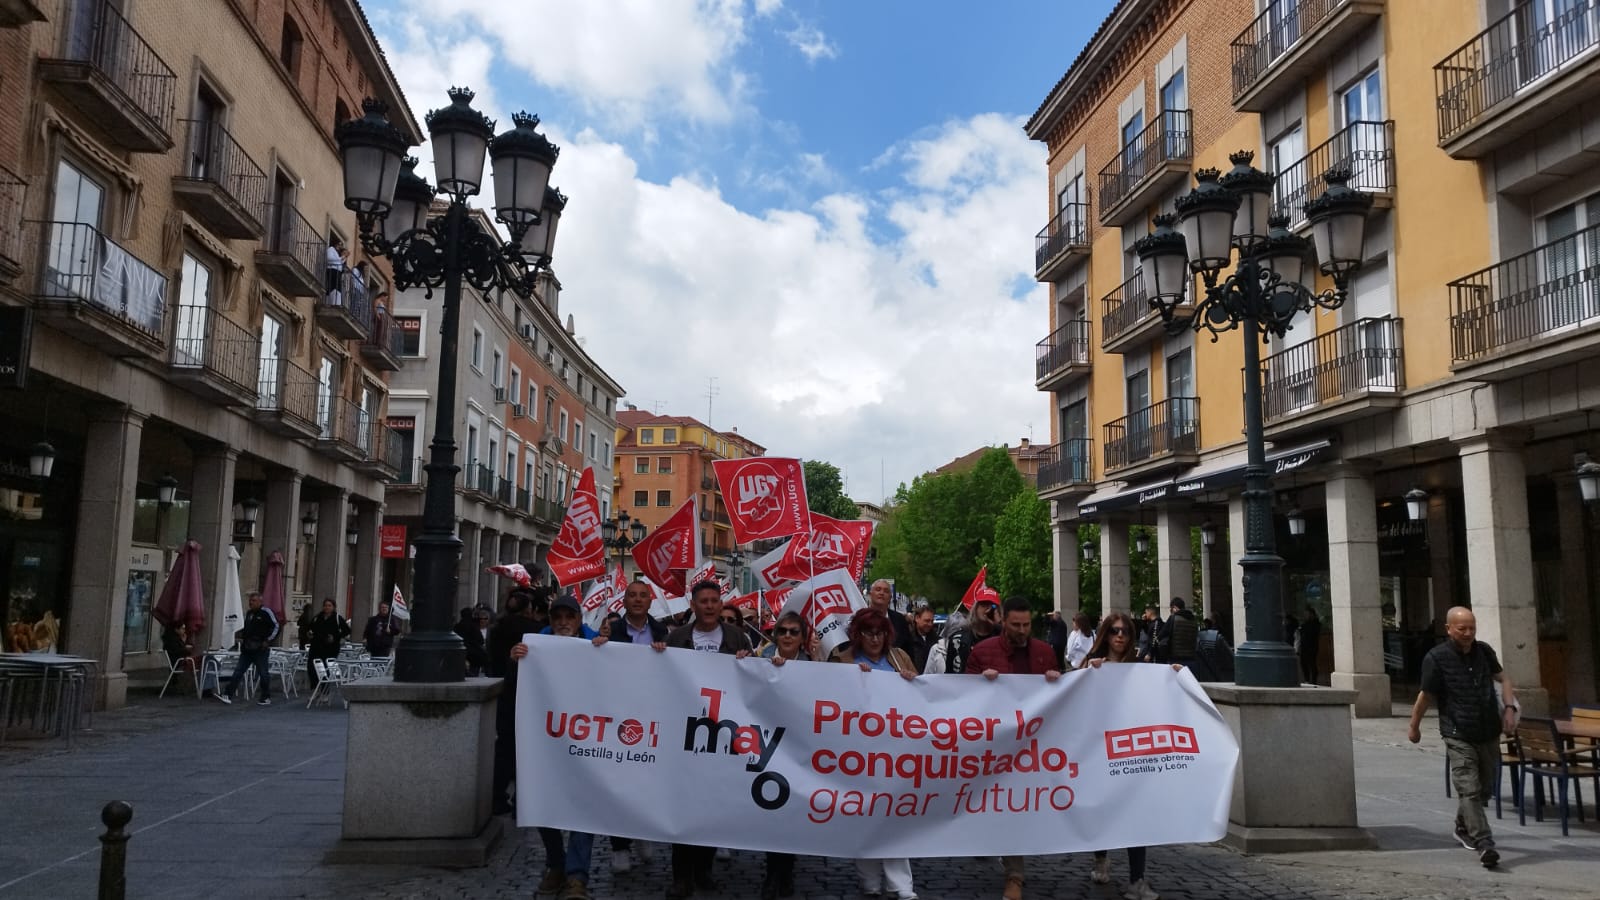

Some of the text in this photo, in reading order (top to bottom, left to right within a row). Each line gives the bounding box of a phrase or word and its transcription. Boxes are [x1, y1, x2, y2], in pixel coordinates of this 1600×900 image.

[738, 474, 780, 502] UGT
[567, 495, 604, 547] UGT
[806, 529, 844, 556] UGT
[807, 589, 849, 624] COO
[545, 710, 614, 743] UGT
[813, 700, 1044, 751] Proteger lo
[568, 744, 656, 763] Castilla y León
[1111, 730, 1193, 754] CCOO
[811, 739, 1079, 789] conquistado,
[1108, 754, 1195, 768] comisiones obreras
[1109, 762, 1188, 776] de Castilla y León
[807, 783, 1075, 824] ganar futuro
